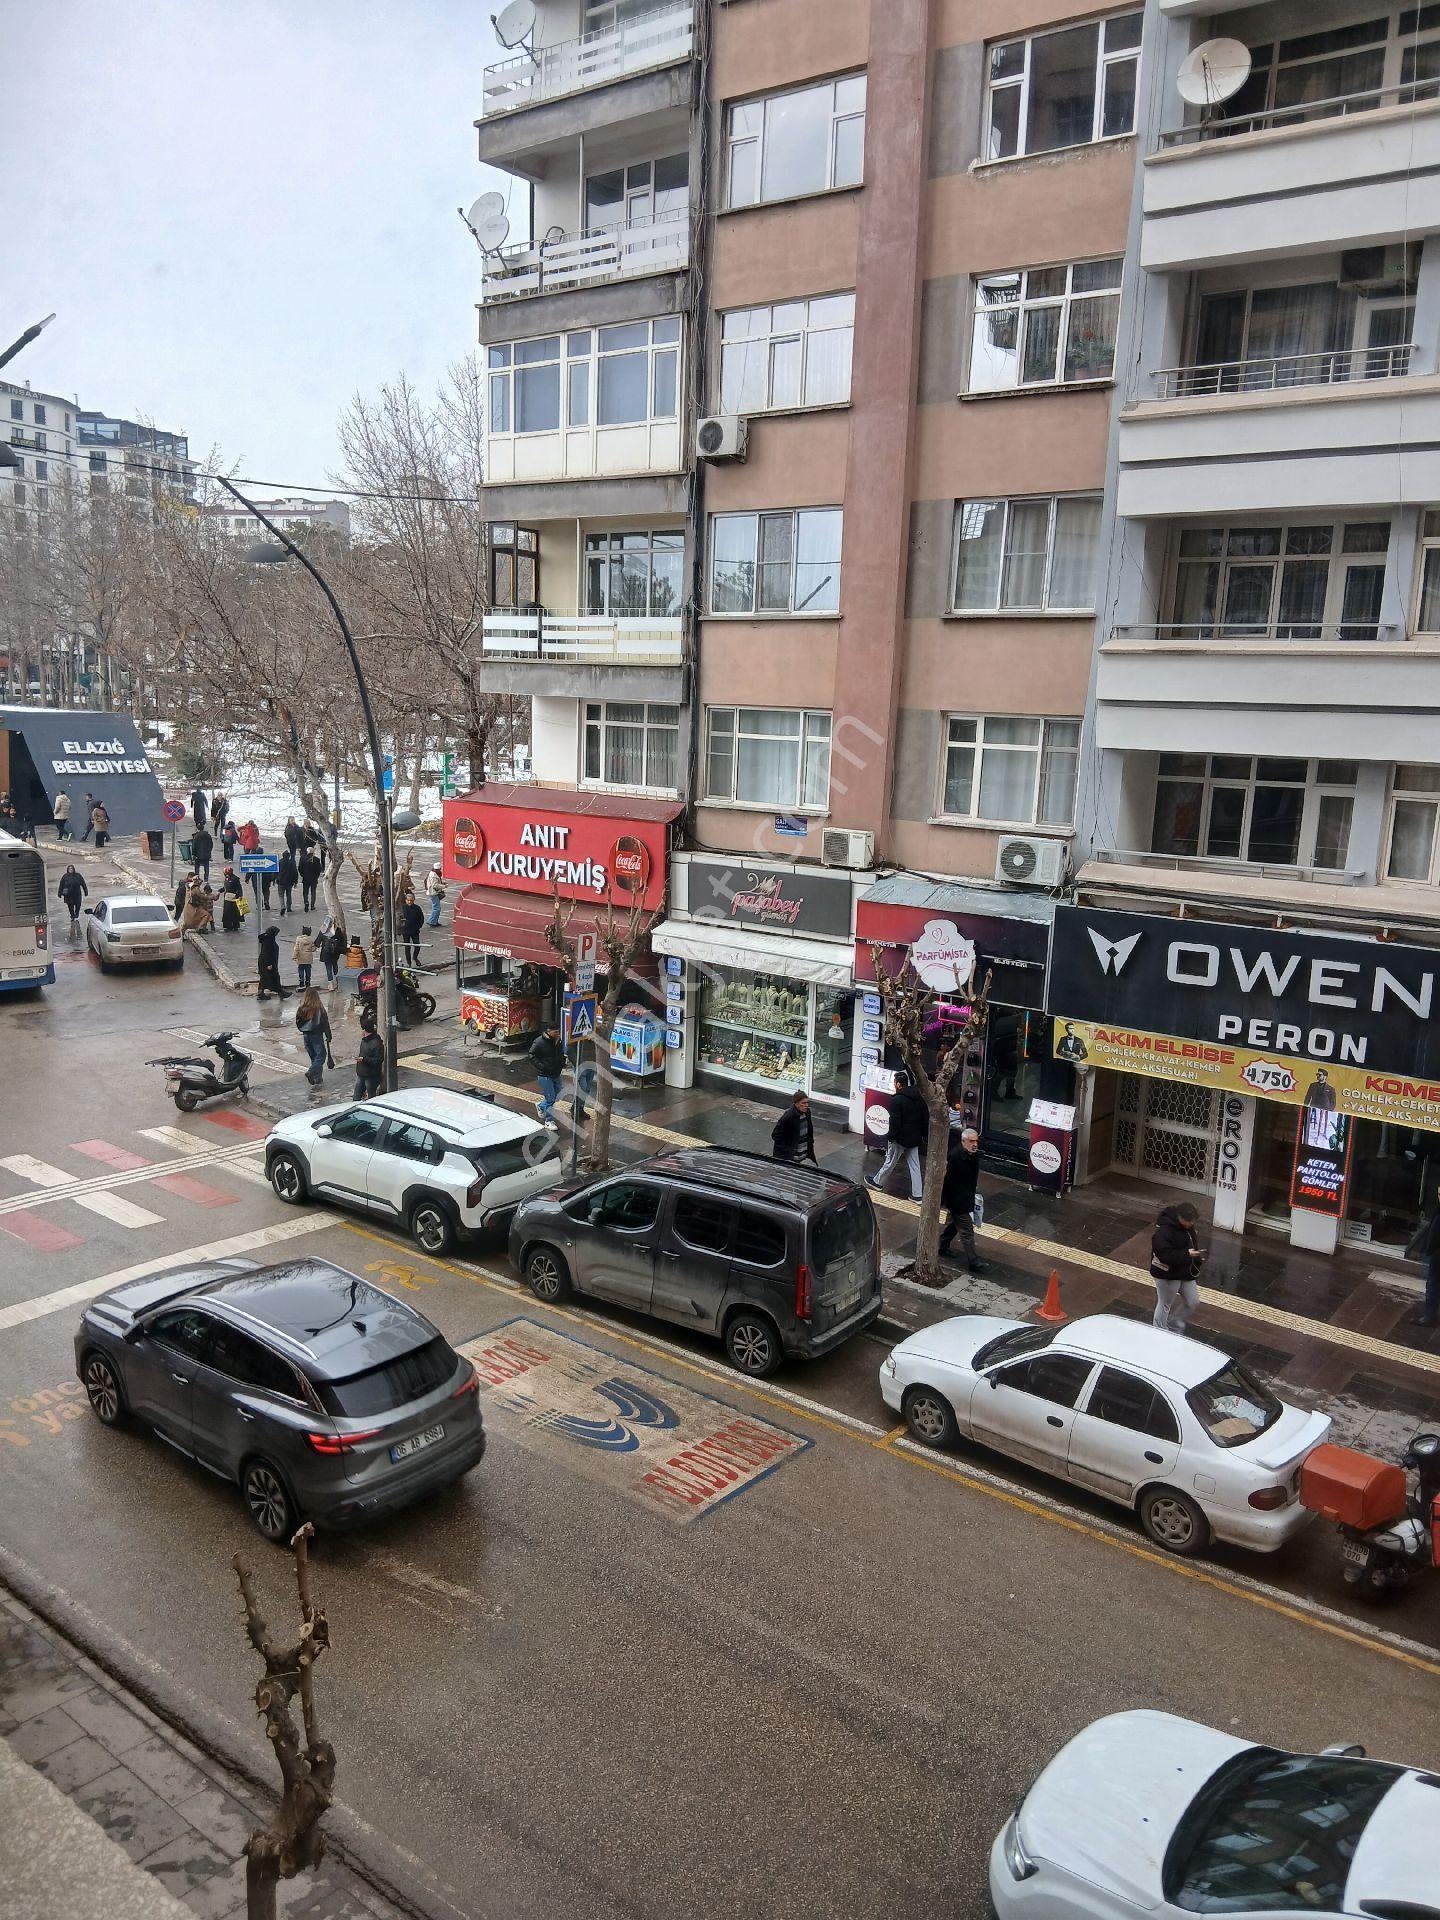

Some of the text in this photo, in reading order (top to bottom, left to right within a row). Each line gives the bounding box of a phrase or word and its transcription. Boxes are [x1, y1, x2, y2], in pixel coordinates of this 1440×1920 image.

[62, 737, 126, 755] ELAZIĞ
[51, 757, 152, 775] BELEDİYESİ
[520, 823, 569, 850] ANIT
[487, 850, 606, 894] KURUYEMİŞ
[731, 879, 801, 924] paşabey
[582, 936, 593, 960] P
[916, 948, 969, 961] PARFÜMİSTA
[1166, 941, 1434, 1019] OWEN
[1085, 1025, 1236, 1065] TAKIM ELBİSE
[1218, 1014, 1368, 1064] PERON
[1246, 1067, 1292, 1089] 4.750
[1297, 1165, 1345, 1182] PANTOLON
[1306, 1158, 1337, 1171] KETEN
[1218, 1181, 1237, 1191] 1993
[1298, 1186, 1338, 1200] 1950 TL
[1301, 1175, 1339, 1191] GÖMLEK
